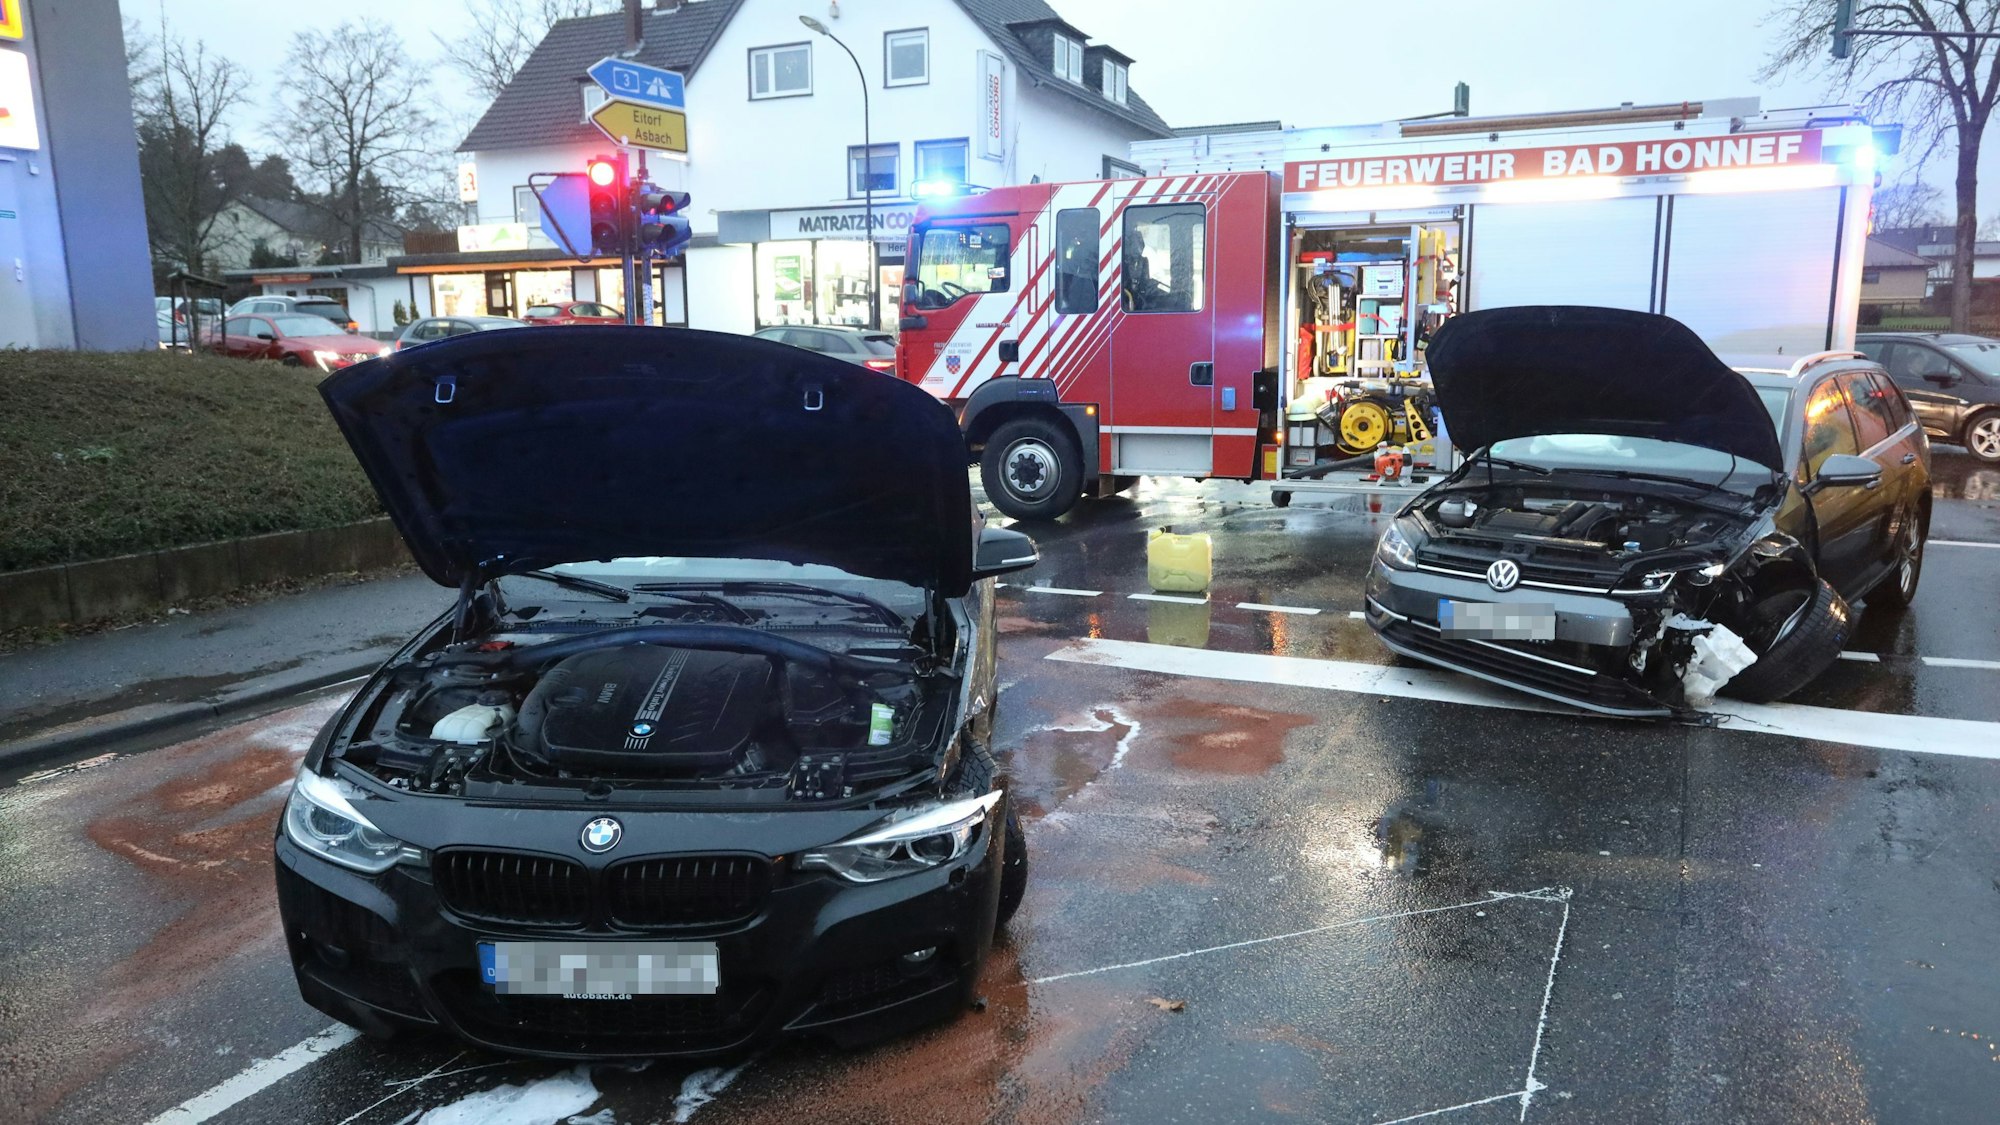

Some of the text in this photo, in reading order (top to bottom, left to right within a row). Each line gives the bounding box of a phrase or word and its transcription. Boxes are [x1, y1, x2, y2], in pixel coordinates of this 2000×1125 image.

[623, 73, 630, 87] 3
[633, 110, 662, 127] Eitorf
[635, 127, 672, 145] Asbach
[1297, 135, 1803, 189] FEUERWEHR BAD HONNEF
[798, 213, 884, 233] MATRATZEN
[597, 682, 617, 703] BMW
